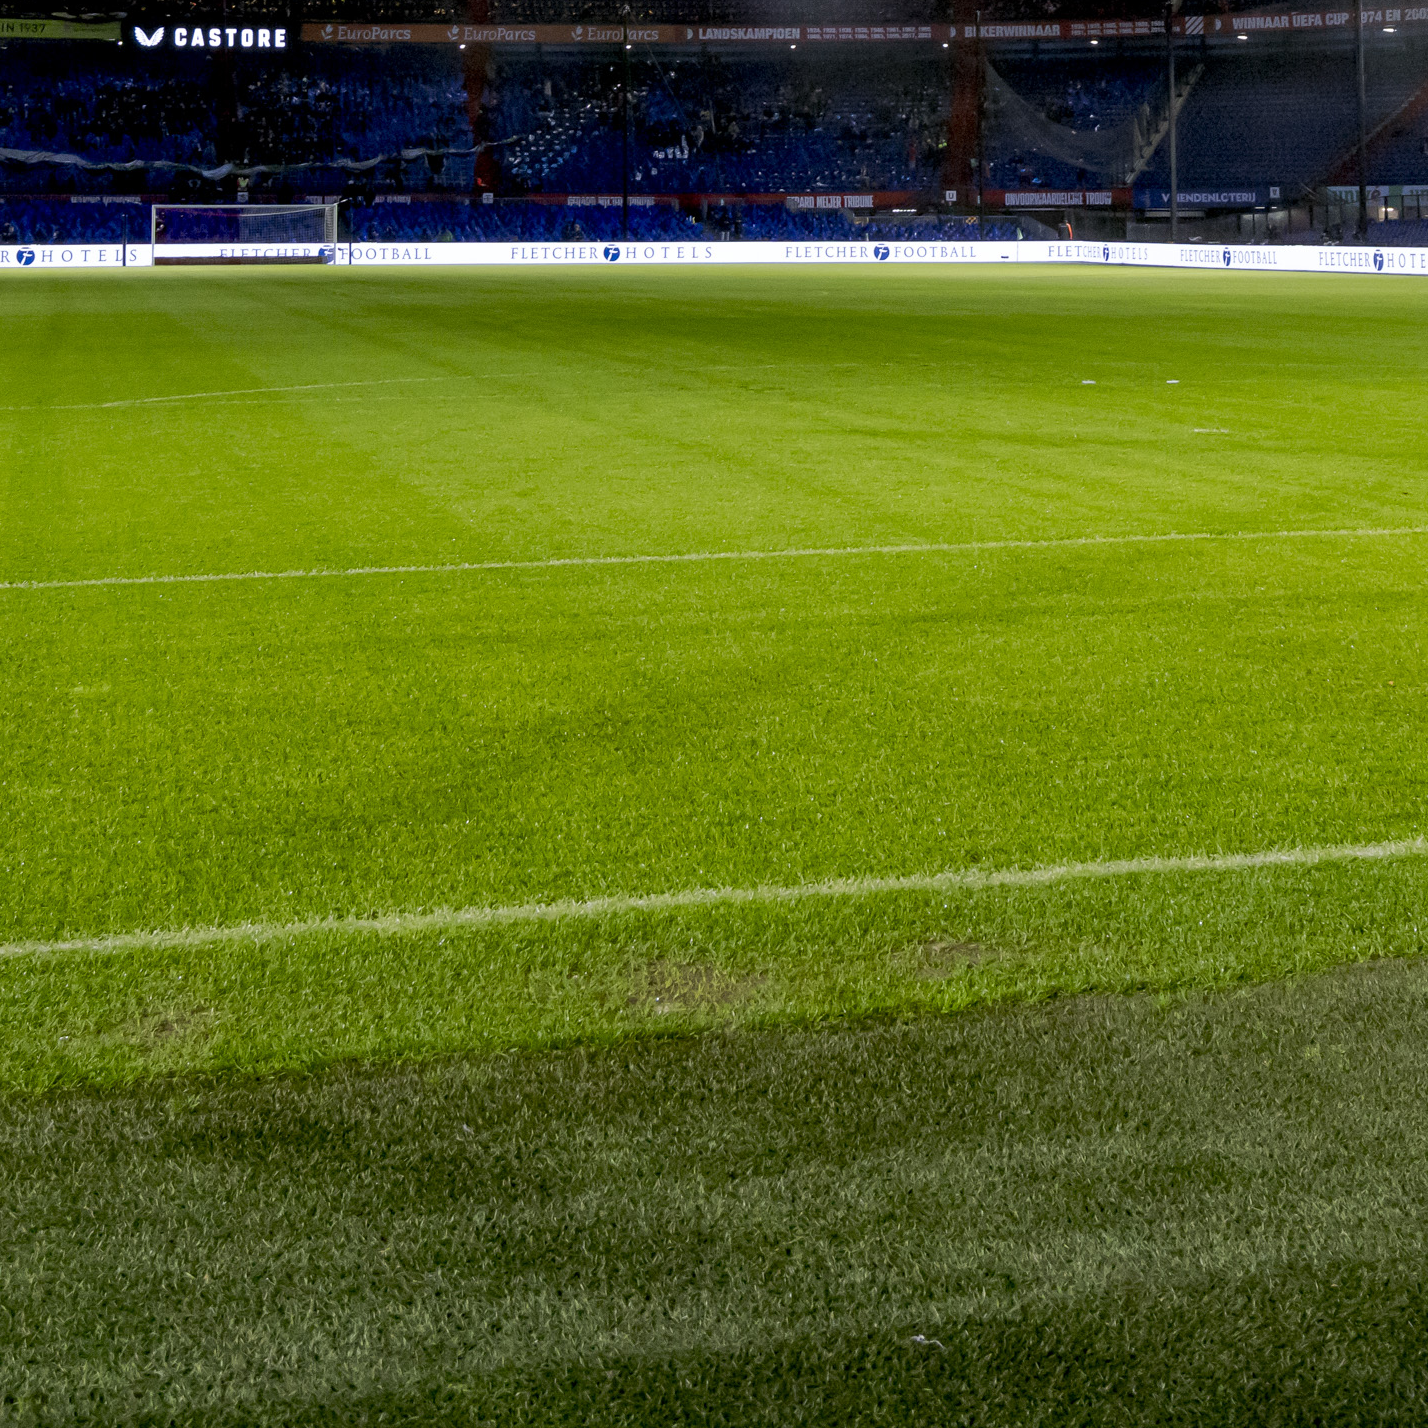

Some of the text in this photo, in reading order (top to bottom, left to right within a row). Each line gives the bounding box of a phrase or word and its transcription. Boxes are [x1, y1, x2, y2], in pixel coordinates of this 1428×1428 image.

[1233, 16, 1290, 30] WINNAAR
[1292, 13, 1323, 27] UEFA
[1325, 12, 1349, 25] CUP
[1386, 9, 1401, 21] EN
[1, 22, 15, 33] IN
[19, 23, 46, 34] 1937
[337, 25, 411, 40] EuroParcs
[463, 27, 536, 41] EuroParcs
[698, 27, 801, 40] LANDSKAMPIOEN
[174, 27, 287, 48] CASTORE
[816, 195, 842, 208] MEIJER
[844, 194, 873, 208] TRIBUNE
[1085, 192, 1112, 205] TROUW
[41, 249, 137, 263] HOTELS
[341, 247, 432, 260] FOOTBALL
[511, 246, 713, 260] FLETCHER HOTELS
[785, 246, 977, 258] FLETCHER FOOTBALL
[1048, 245, 1149, 261] FLETCHER HOTELS
[1180, 249, 1278, 265] FLETCHER FOOTBALL
[1319, 251, 1371, 267] FLETCHER
